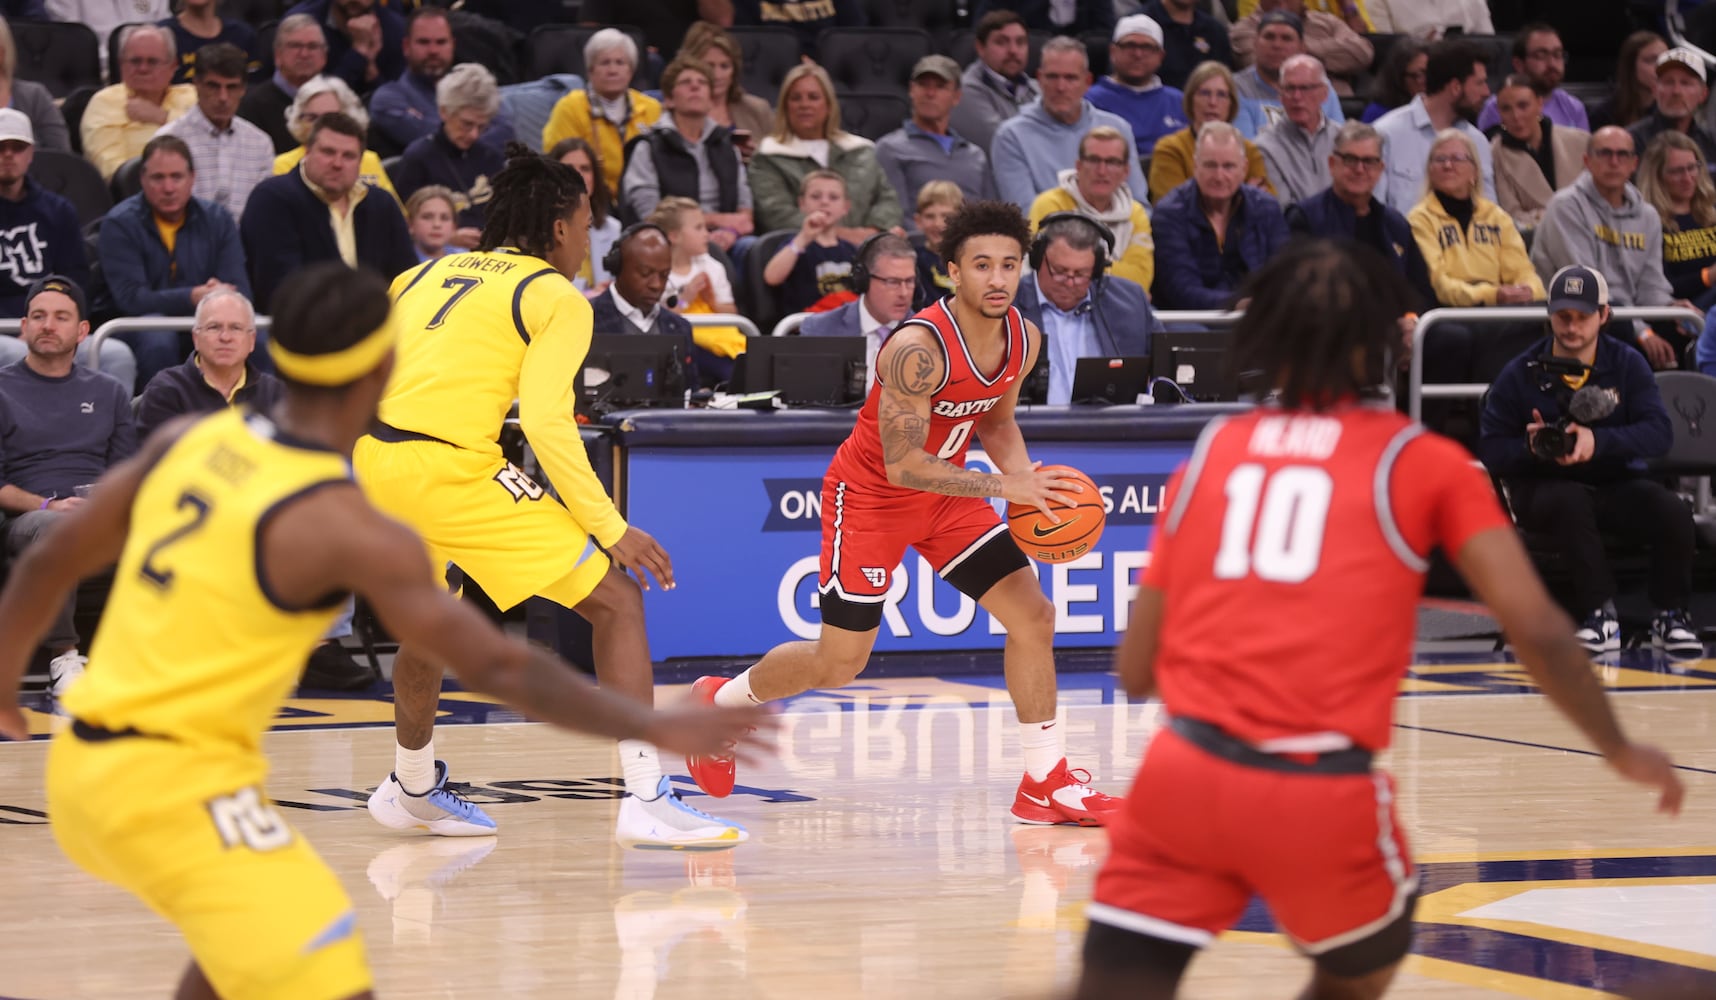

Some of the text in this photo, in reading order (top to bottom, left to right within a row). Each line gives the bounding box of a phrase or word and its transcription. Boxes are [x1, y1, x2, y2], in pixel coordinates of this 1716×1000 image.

[448, 255, 518, 275] LOWERY
[424, 274, 484, 331] 7
[936, 419, 976, 461] 0
[139, 486, 213, 589] 2
[1212, 461, 1335, 585] 10
[777, 551, 1154, 641] GRUE
